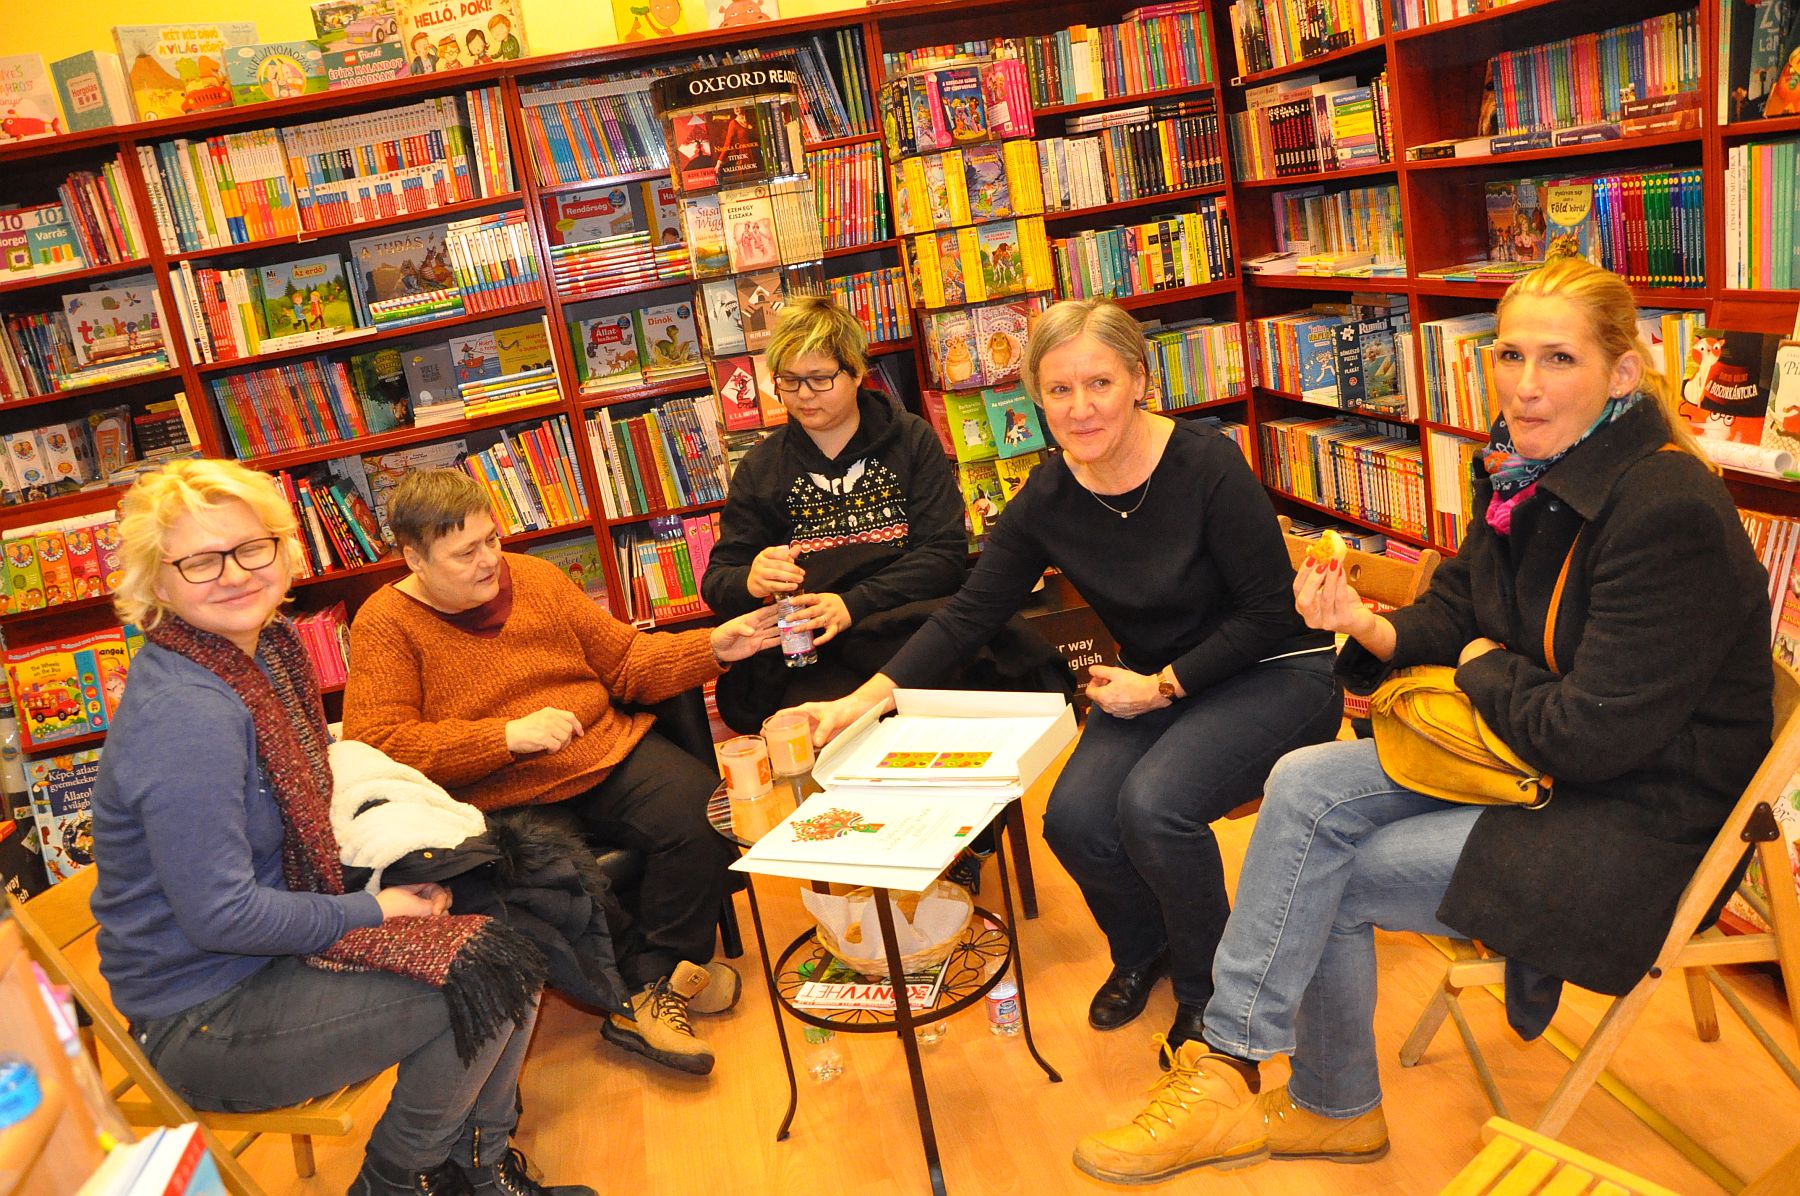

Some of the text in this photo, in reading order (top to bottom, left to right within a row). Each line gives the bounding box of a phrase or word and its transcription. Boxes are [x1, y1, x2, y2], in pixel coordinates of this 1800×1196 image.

[460, 0, 493, 18] DOKI!
[168, 43, 198, 54] VILÁG
[355, 58, 403, 76] KALANDOT
[689, 71, 766, 95] OXFORD
[566, 203, 608, 216] Rendőrség
[696, 207, 720, 219] Susa
[1551, 202, 1567, 213] Föld
[35, 207, 70, 227] 101
[35, 227, 68, 241] Varrás
[360, 235, 424, 258] A TUDÁS
[294, 266, 323, 278] Az erdő
[596, 327, 617, 337] Állat
[1068, 638, 1094, 652] way
[48, 770, 75, 783] Képes
[68, 799, 90, 811] világb
[5, 875, 20, 893] way
